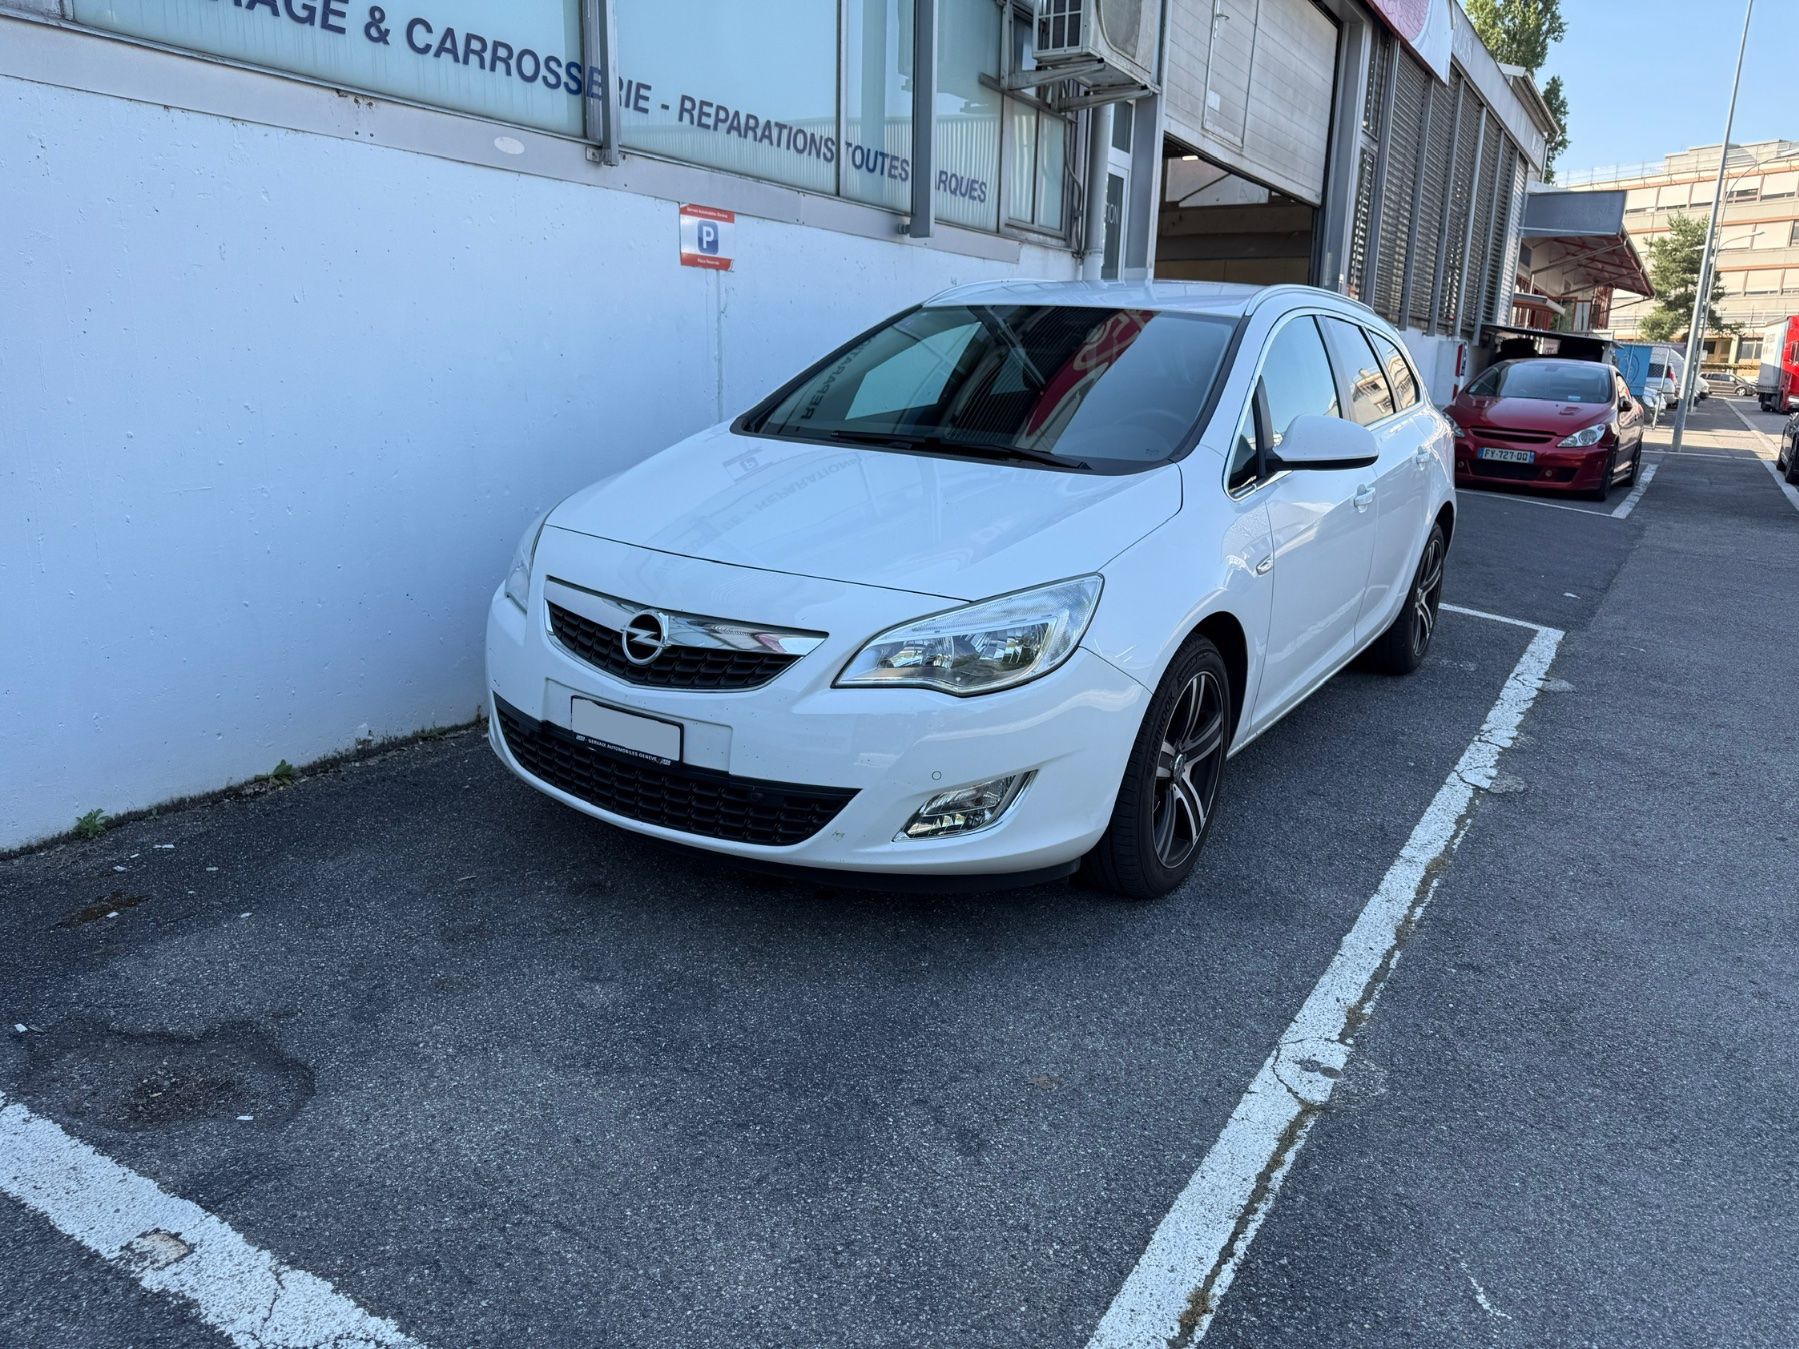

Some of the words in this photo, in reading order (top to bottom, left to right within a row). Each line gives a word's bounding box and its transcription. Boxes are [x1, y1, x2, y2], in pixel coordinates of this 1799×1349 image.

[364, 5, 391, 46] &
[678, 94, 836, 164] REPARATIONS
[702, 226, 715, 249] P
